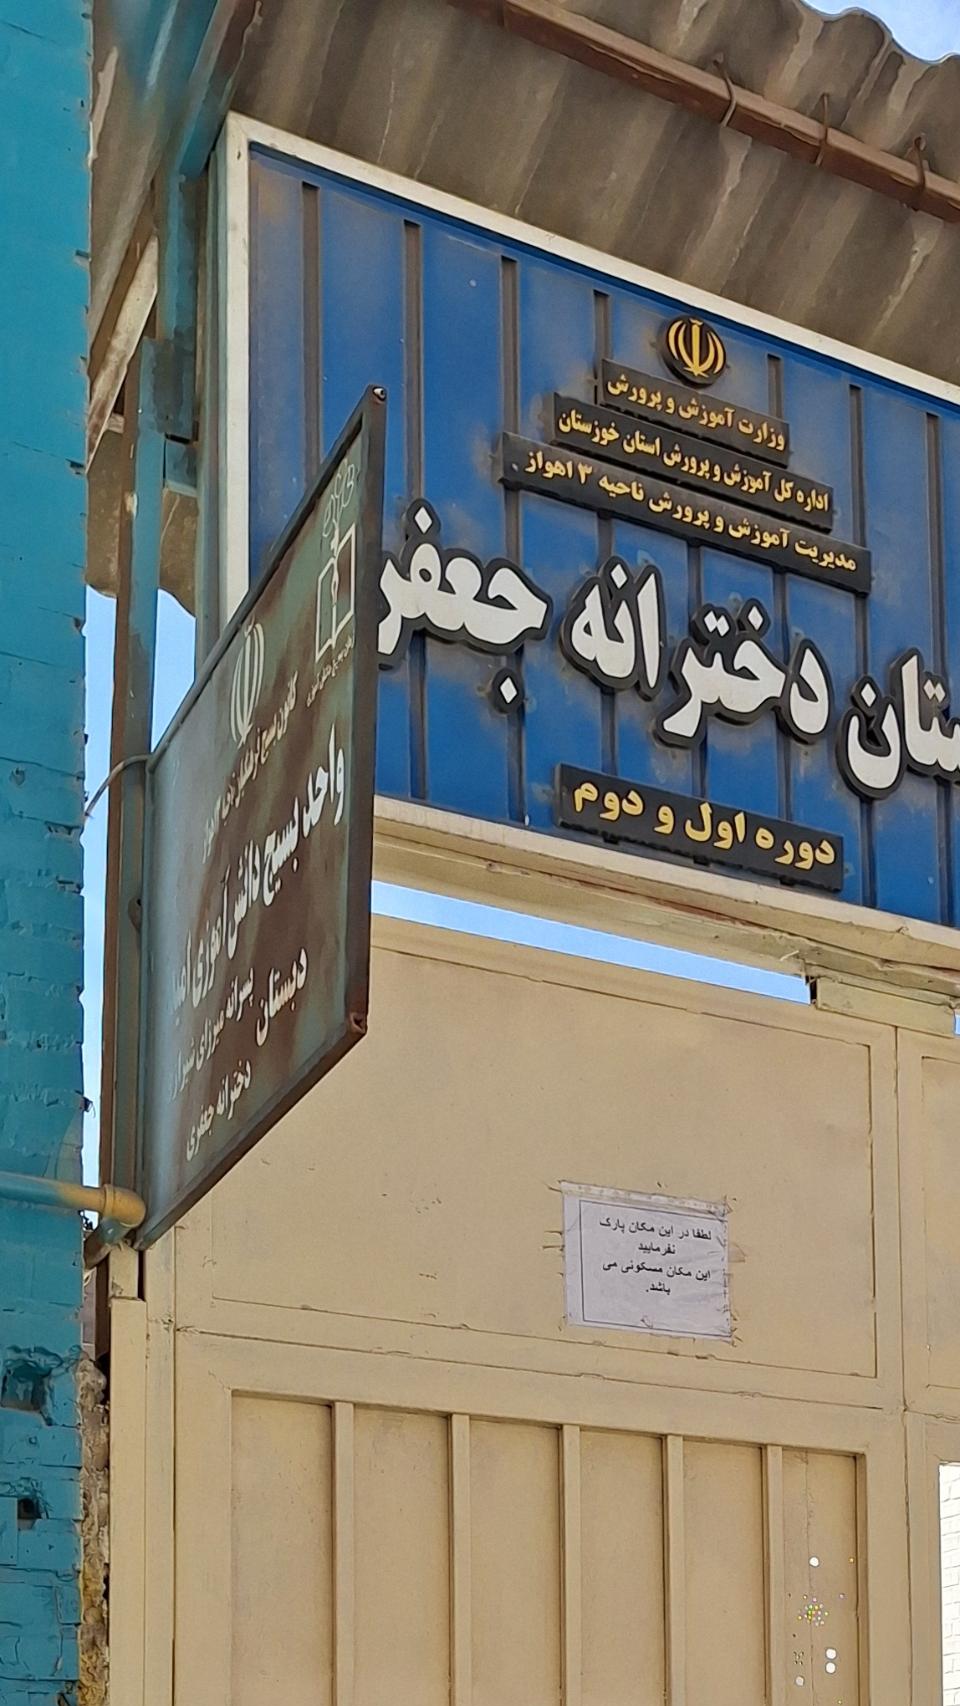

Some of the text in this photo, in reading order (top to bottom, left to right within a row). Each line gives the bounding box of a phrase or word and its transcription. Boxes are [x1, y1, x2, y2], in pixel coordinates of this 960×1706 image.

[558, 408, 829, 513] اداره کل آموزش و پرورش استان خوزستان
[607, 373, 786, 451] وزارت آموزش و پرورش
[524, 450, 857, 572] مدیریت آموزش و پرورش ناحیه ۳ اهواز
[376, 505, 548, 704] جعفر
[571, 562, 829, 740] دخترانه
[302, 722, 345, 839] واحد
[573, 778, 837, 869] دوره اول و دوم
[228, 840, 261, 960] دانش
[262, 797, 299, 907] بسیج
[191, 863, 230, 1009] آموزی
[225, 967, 254, 1022] پسرانه
[256, 947, 308, 1047] دبستان
[186, 1058, 251, 1162] دخترانه جعفری
[599, 1217, 712, 1241] لطفا در این مکان پارک
[602, 1260, 711, 1281] این مکان مسکونی می
[638, 1242, 676, 1256] نفرمایید
[645, 1281, 671, 1295] باشد.
